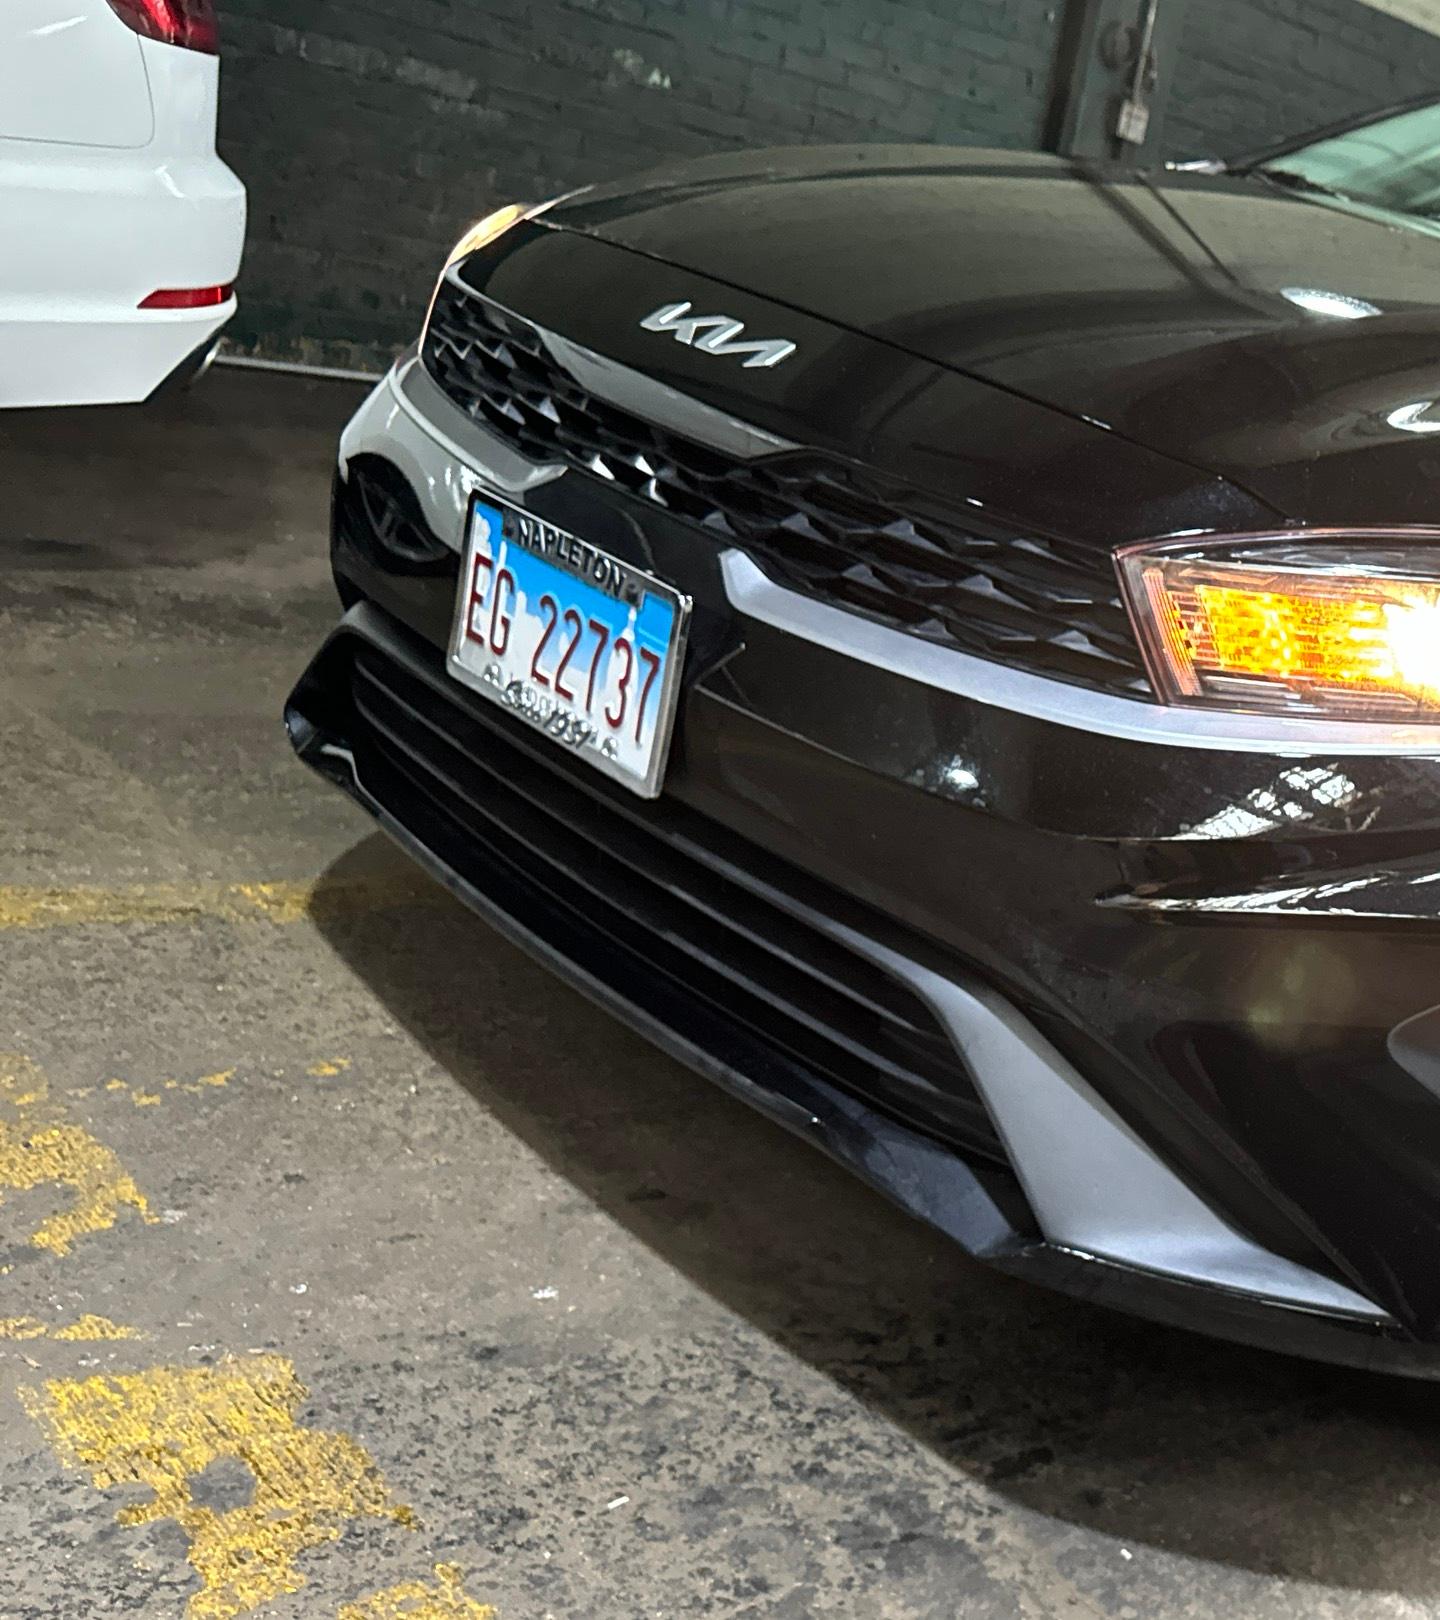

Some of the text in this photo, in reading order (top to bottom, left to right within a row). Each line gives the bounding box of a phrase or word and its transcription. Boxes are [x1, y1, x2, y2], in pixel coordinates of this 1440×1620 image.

[640, 301, 797, 368] KIA
[518, 515, 628, 596] NAPLETON
[465, 551, 661, 746] EG 22737
